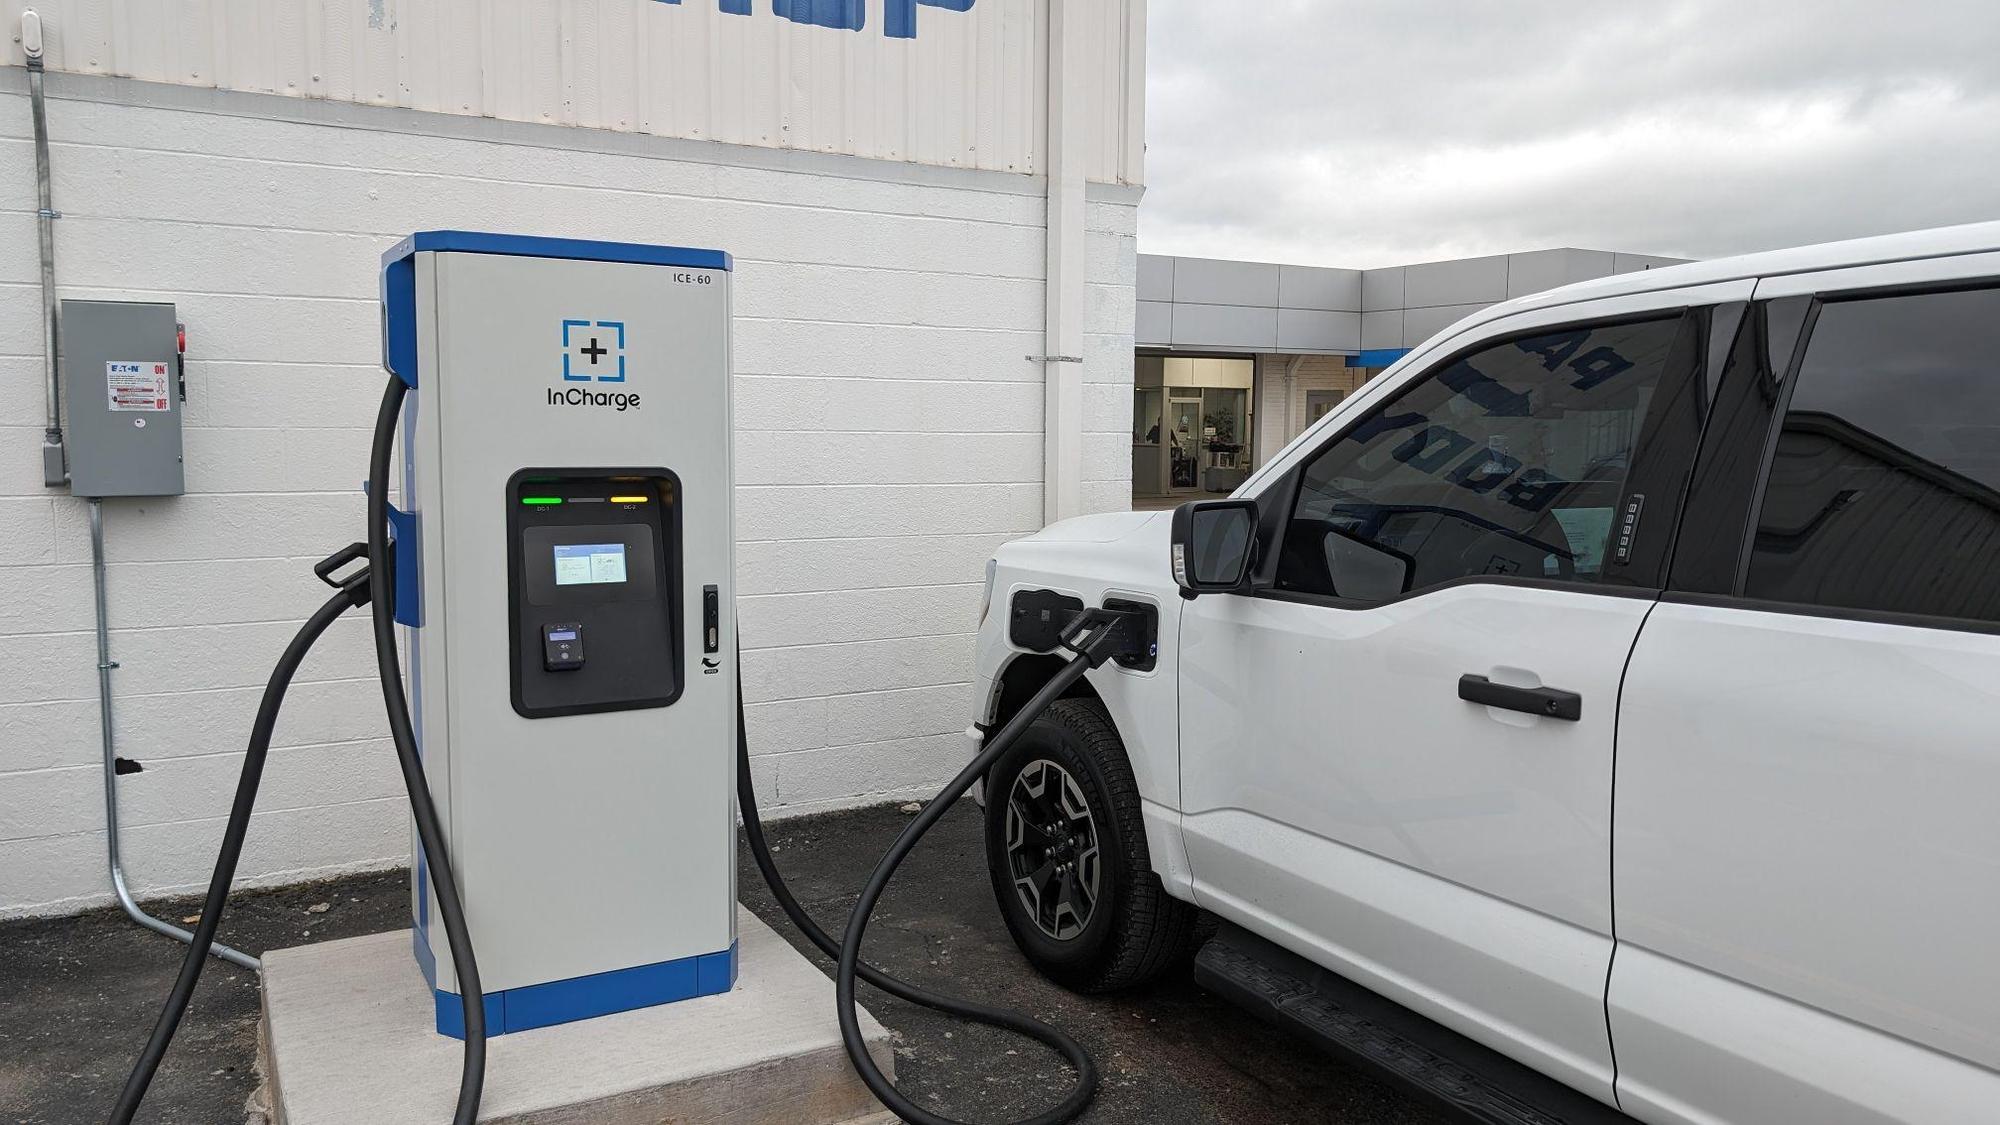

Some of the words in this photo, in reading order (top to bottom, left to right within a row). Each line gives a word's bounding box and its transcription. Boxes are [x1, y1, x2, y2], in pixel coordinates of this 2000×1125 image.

[673, 273, 711, 285] ICE-60
[154, 364, 165, 374] ON
[156, 398, 167, 409] OFF
[547, 388, 641, 411] InCharge
